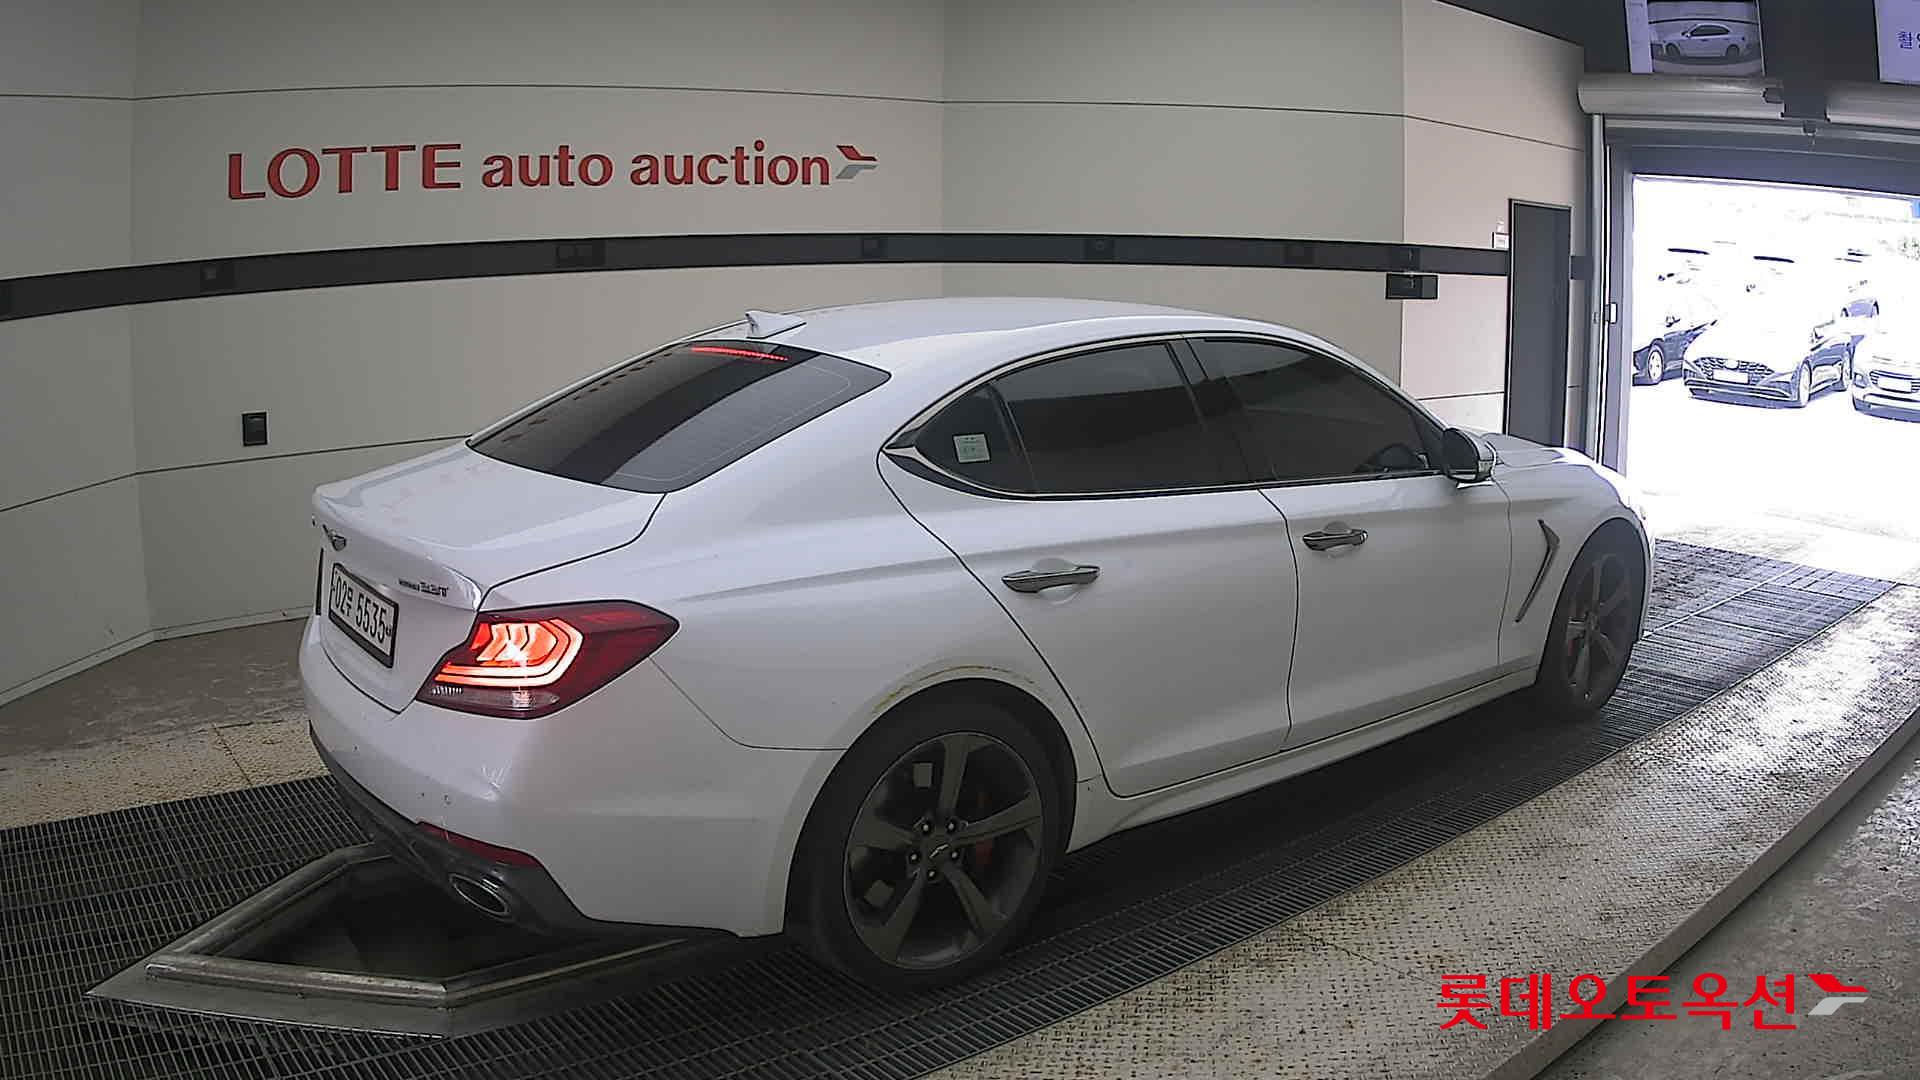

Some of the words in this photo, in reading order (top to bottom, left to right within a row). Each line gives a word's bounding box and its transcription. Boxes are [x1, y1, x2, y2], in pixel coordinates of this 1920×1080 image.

[227, 143, 462, 200] LOTTE
[481, 145, 614, 189] auto
[629, 141, 831, 187] auction
[356, 592, 388, 644] 5535
